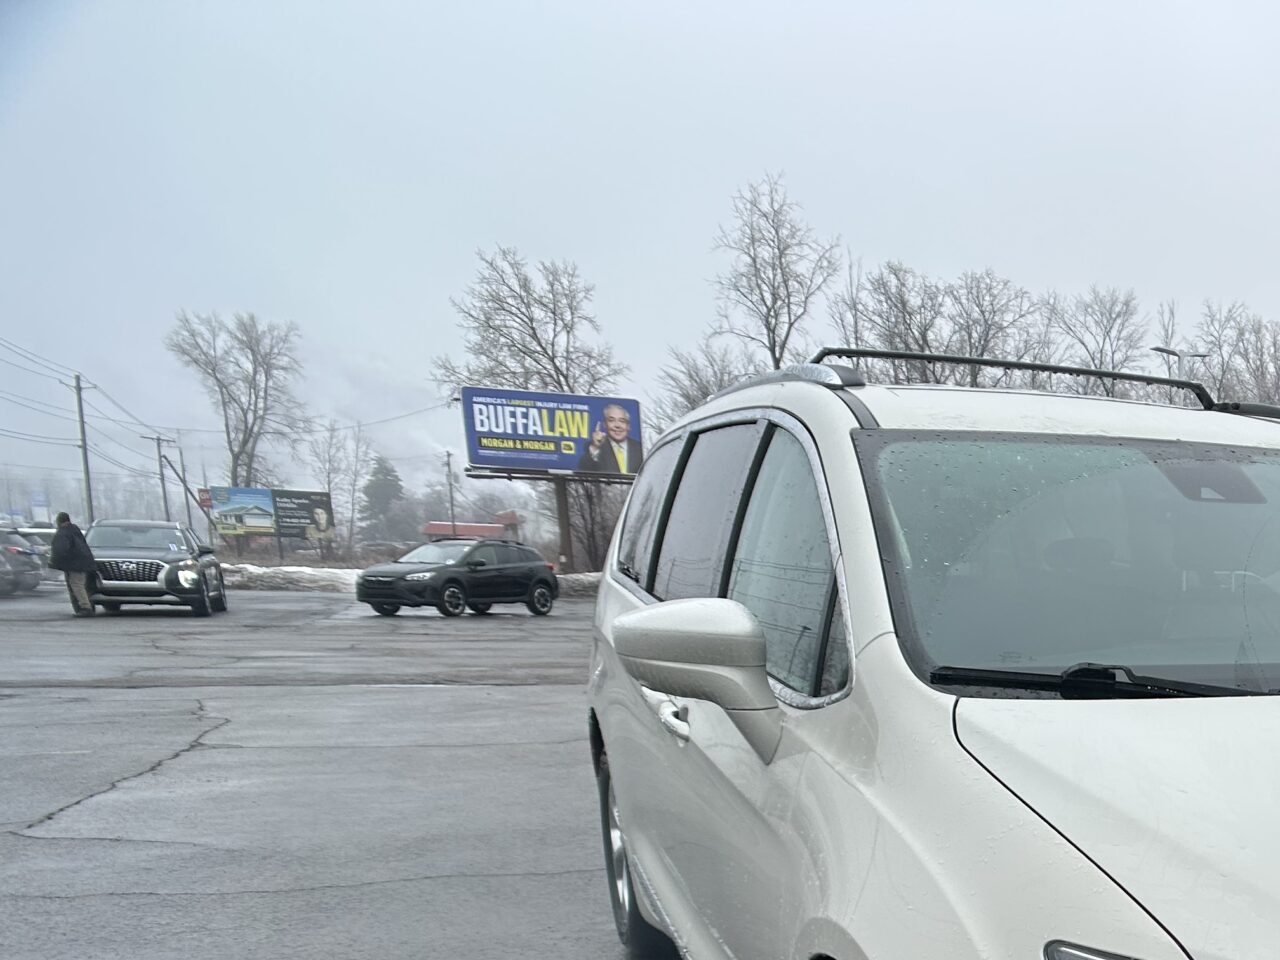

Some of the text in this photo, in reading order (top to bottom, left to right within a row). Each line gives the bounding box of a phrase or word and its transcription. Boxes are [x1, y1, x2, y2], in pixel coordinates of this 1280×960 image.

[472, 403, 590, 439] BUFFALAW
[480, 437, 556, 451] MORGAN & MORGAN
